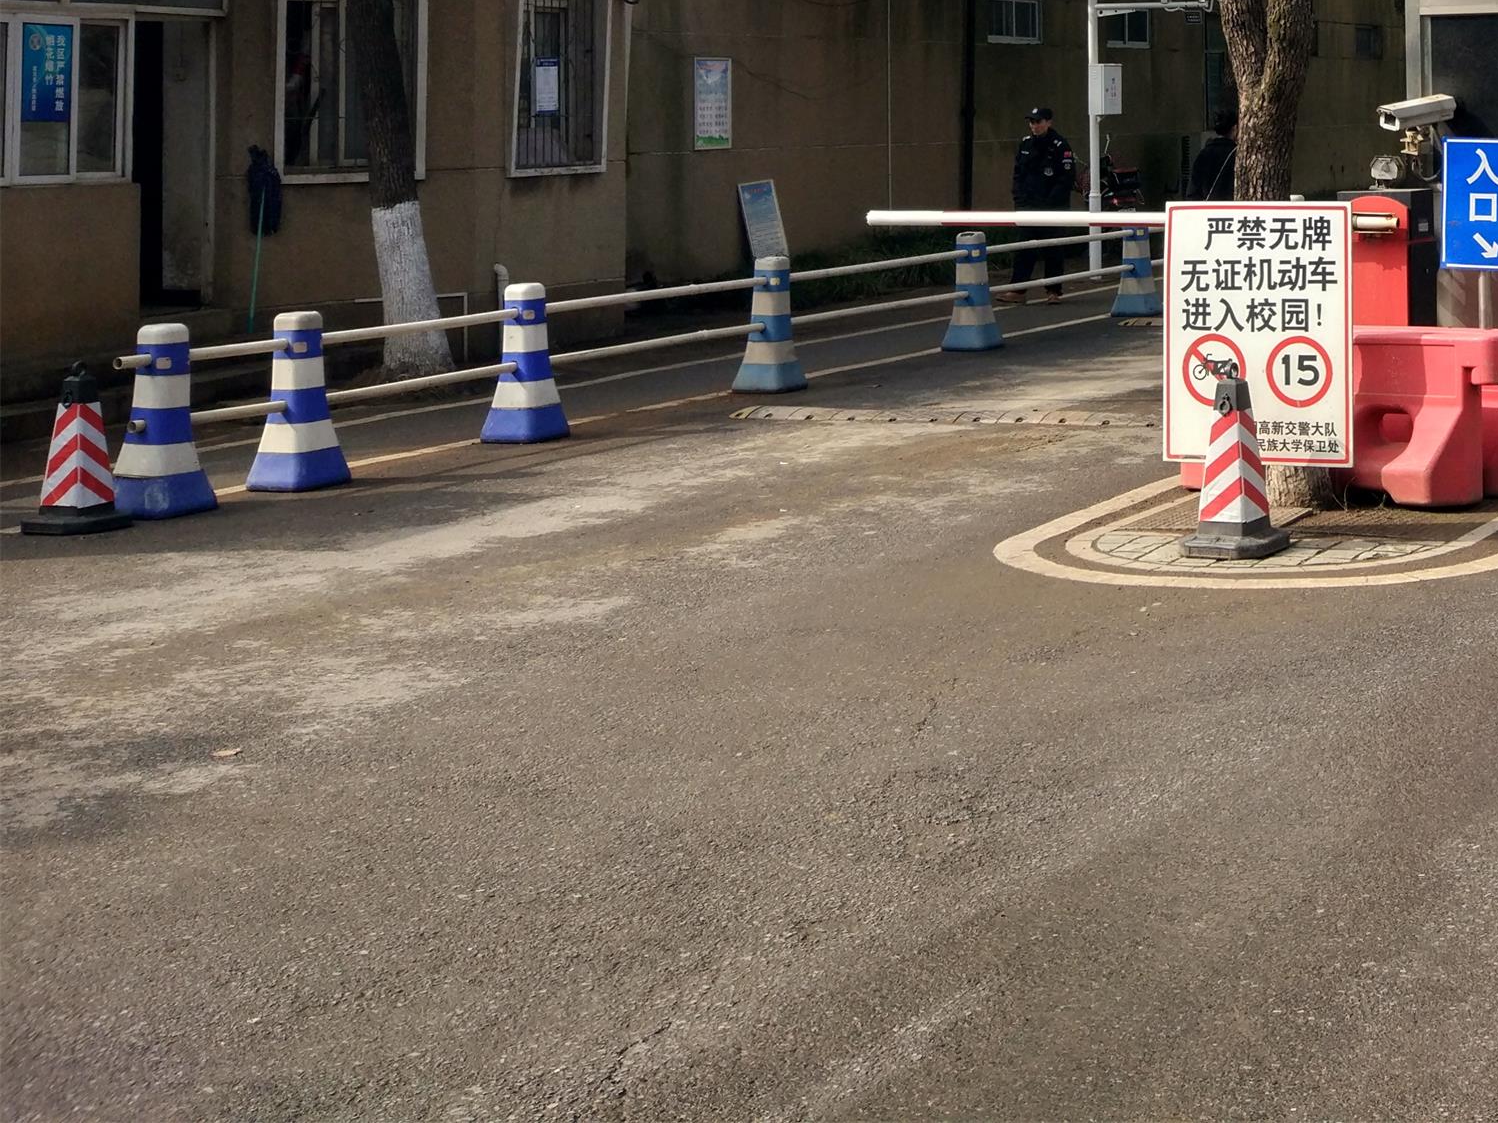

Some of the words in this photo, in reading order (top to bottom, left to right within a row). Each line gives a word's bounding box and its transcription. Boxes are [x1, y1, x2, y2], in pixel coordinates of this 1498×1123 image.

[1204, 217, 1332, 251] 严禁无牌
[1181, 256, 1338, 292] 无证机动车
[1281, 354, 1319, 386] 15
